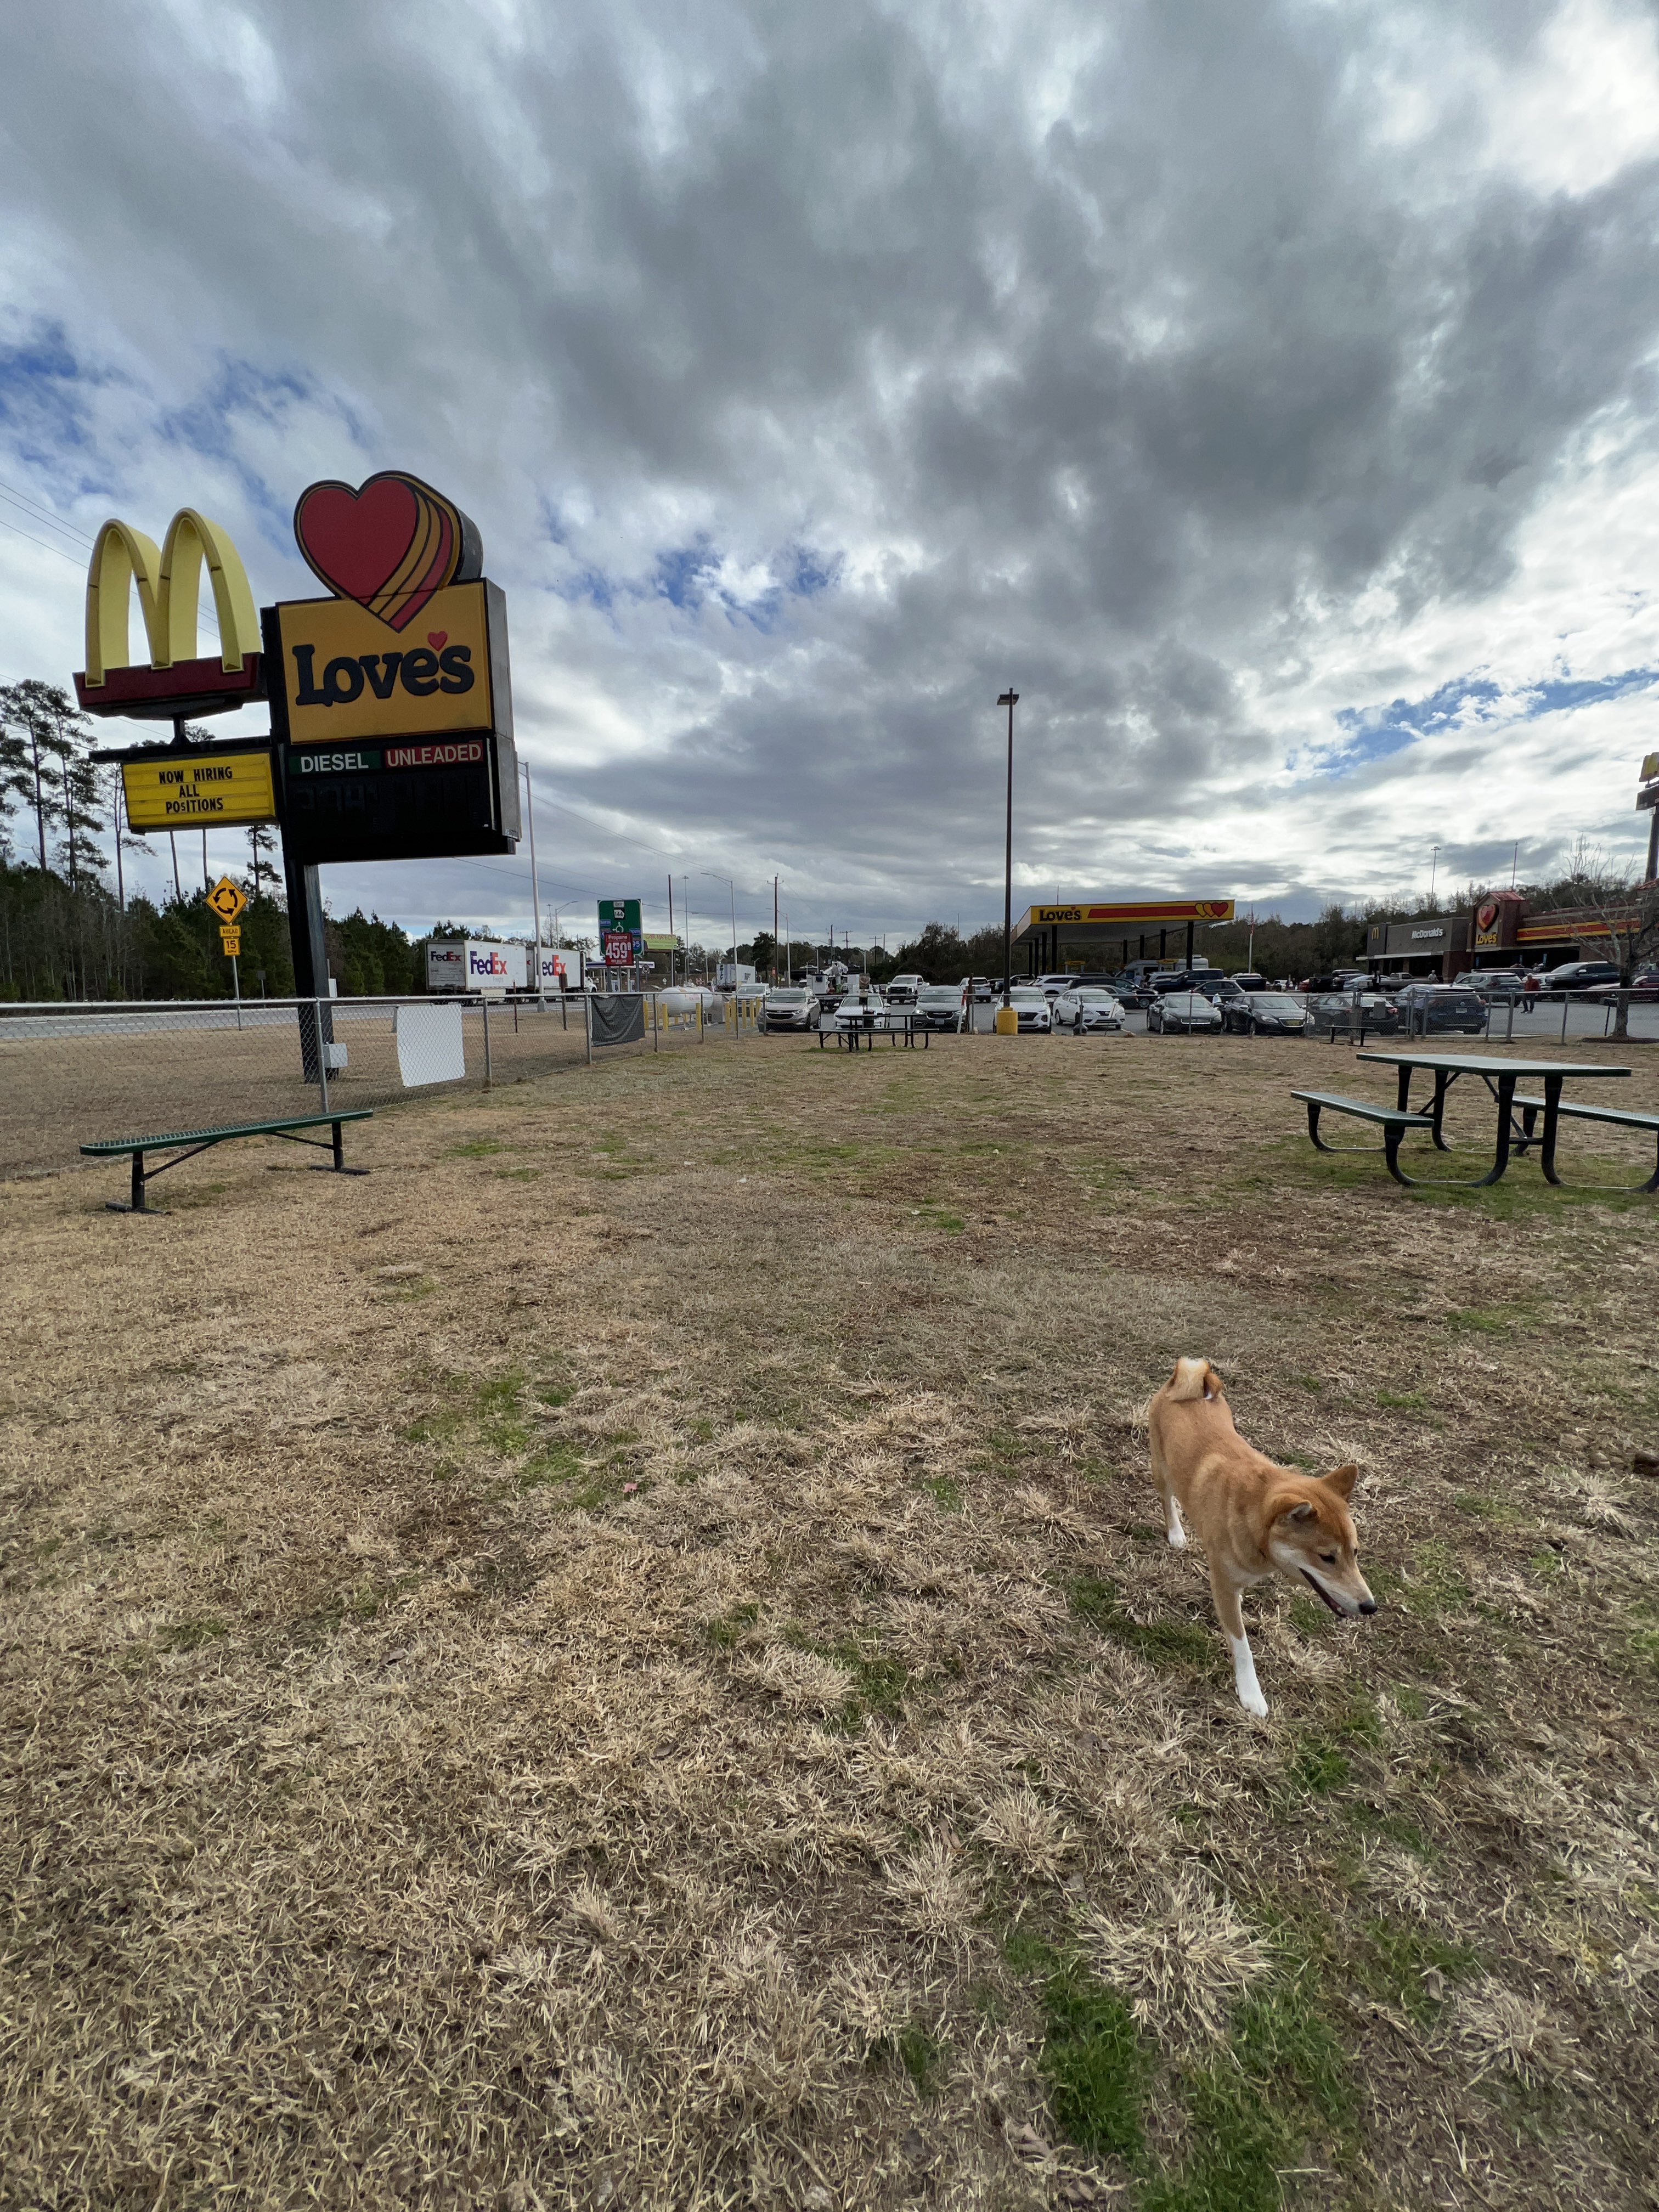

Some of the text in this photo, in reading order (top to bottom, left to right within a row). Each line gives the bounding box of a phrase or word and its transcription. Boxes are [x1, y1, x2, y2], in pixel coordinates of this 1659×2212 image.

[301, 753, 369, 773] DIESEL
[386, 743, 482, 767] UNLEADED
[159, 766, 233, 785] NOW HIRING
[179, 784, 200, 798] ALL
[1411, 927, 1444, 940] McDonald's
[227, 940, 236, 949] 15
[430, 951, 462, 962] FedEx
[470, 950, 508, 975] FedEx
